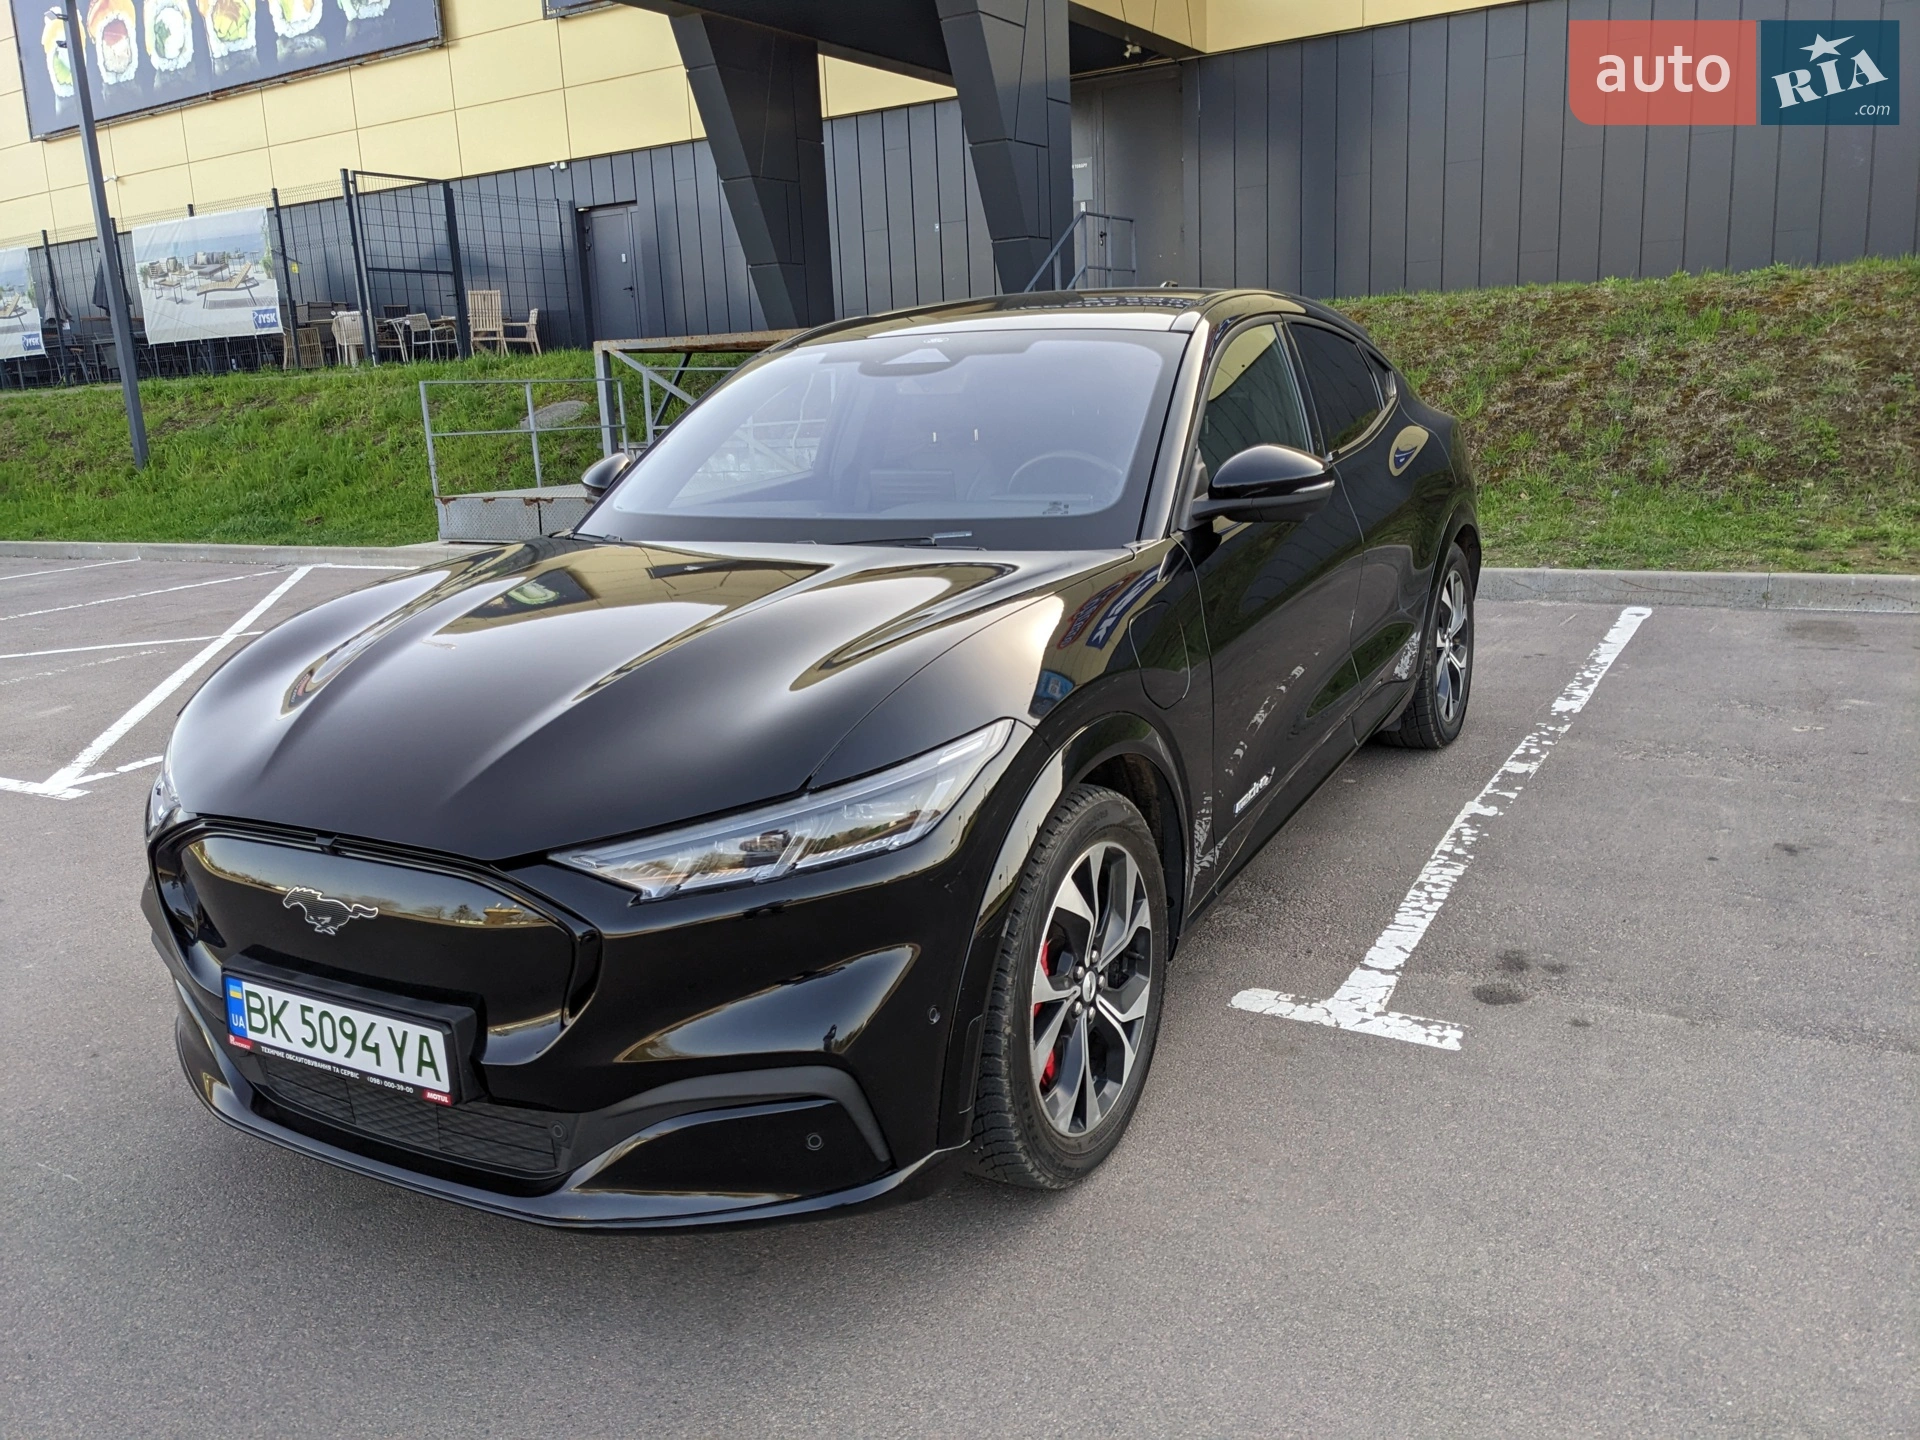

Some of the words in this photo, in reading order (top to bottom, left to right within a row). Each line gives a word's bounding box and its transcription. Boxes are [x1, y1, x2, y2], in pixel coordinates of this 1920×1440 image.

[258, 312, 277, 324] JYSK
[231, 1012, 246, 1030] UA
[340, 1068, 360, 1080] СЕРВІС
[426, 1091, 449, 1103] MOTUL
